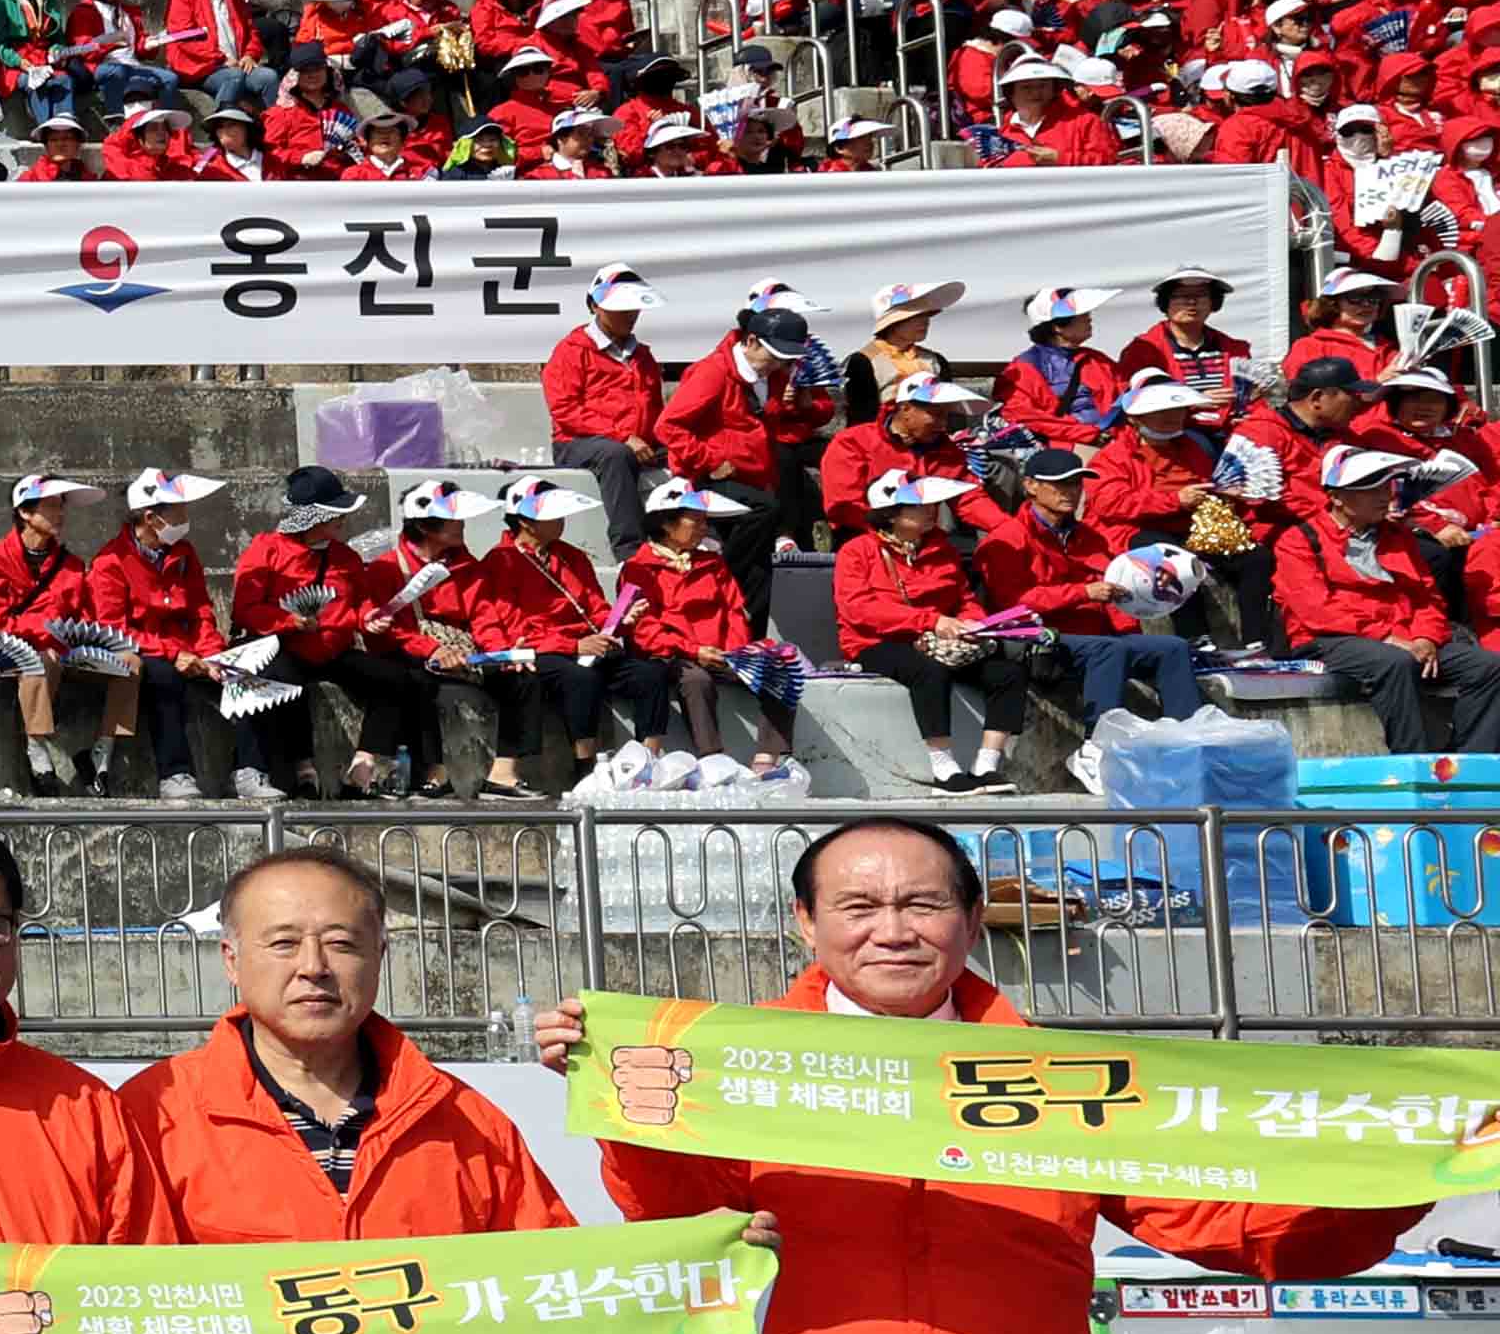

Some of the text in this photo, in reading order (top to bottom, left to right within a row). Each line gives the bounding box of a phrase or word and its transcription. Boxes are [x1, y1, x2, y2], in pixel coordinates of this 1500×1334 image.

[210, 214, 573, 319] 옹진군
[721, 1045, 912, 1084] 2023 인천시민
[717, 1074, 913, 1121] 생활 체육대회
[948, 1055, 1143, 1129] 동구
[1155, 1085, 1221, 1134] 가
[980, 1149, 1260, 1192] 인천광역시동구체육회
[77, 1282, 245, 1312] 2023 인천시민
[454, 1276, 510, 1326] 가
[1162, 1288, 1259, 1309] 일반쓰레기
[1310, 1287, 1408, 1309] 플라스틱류
